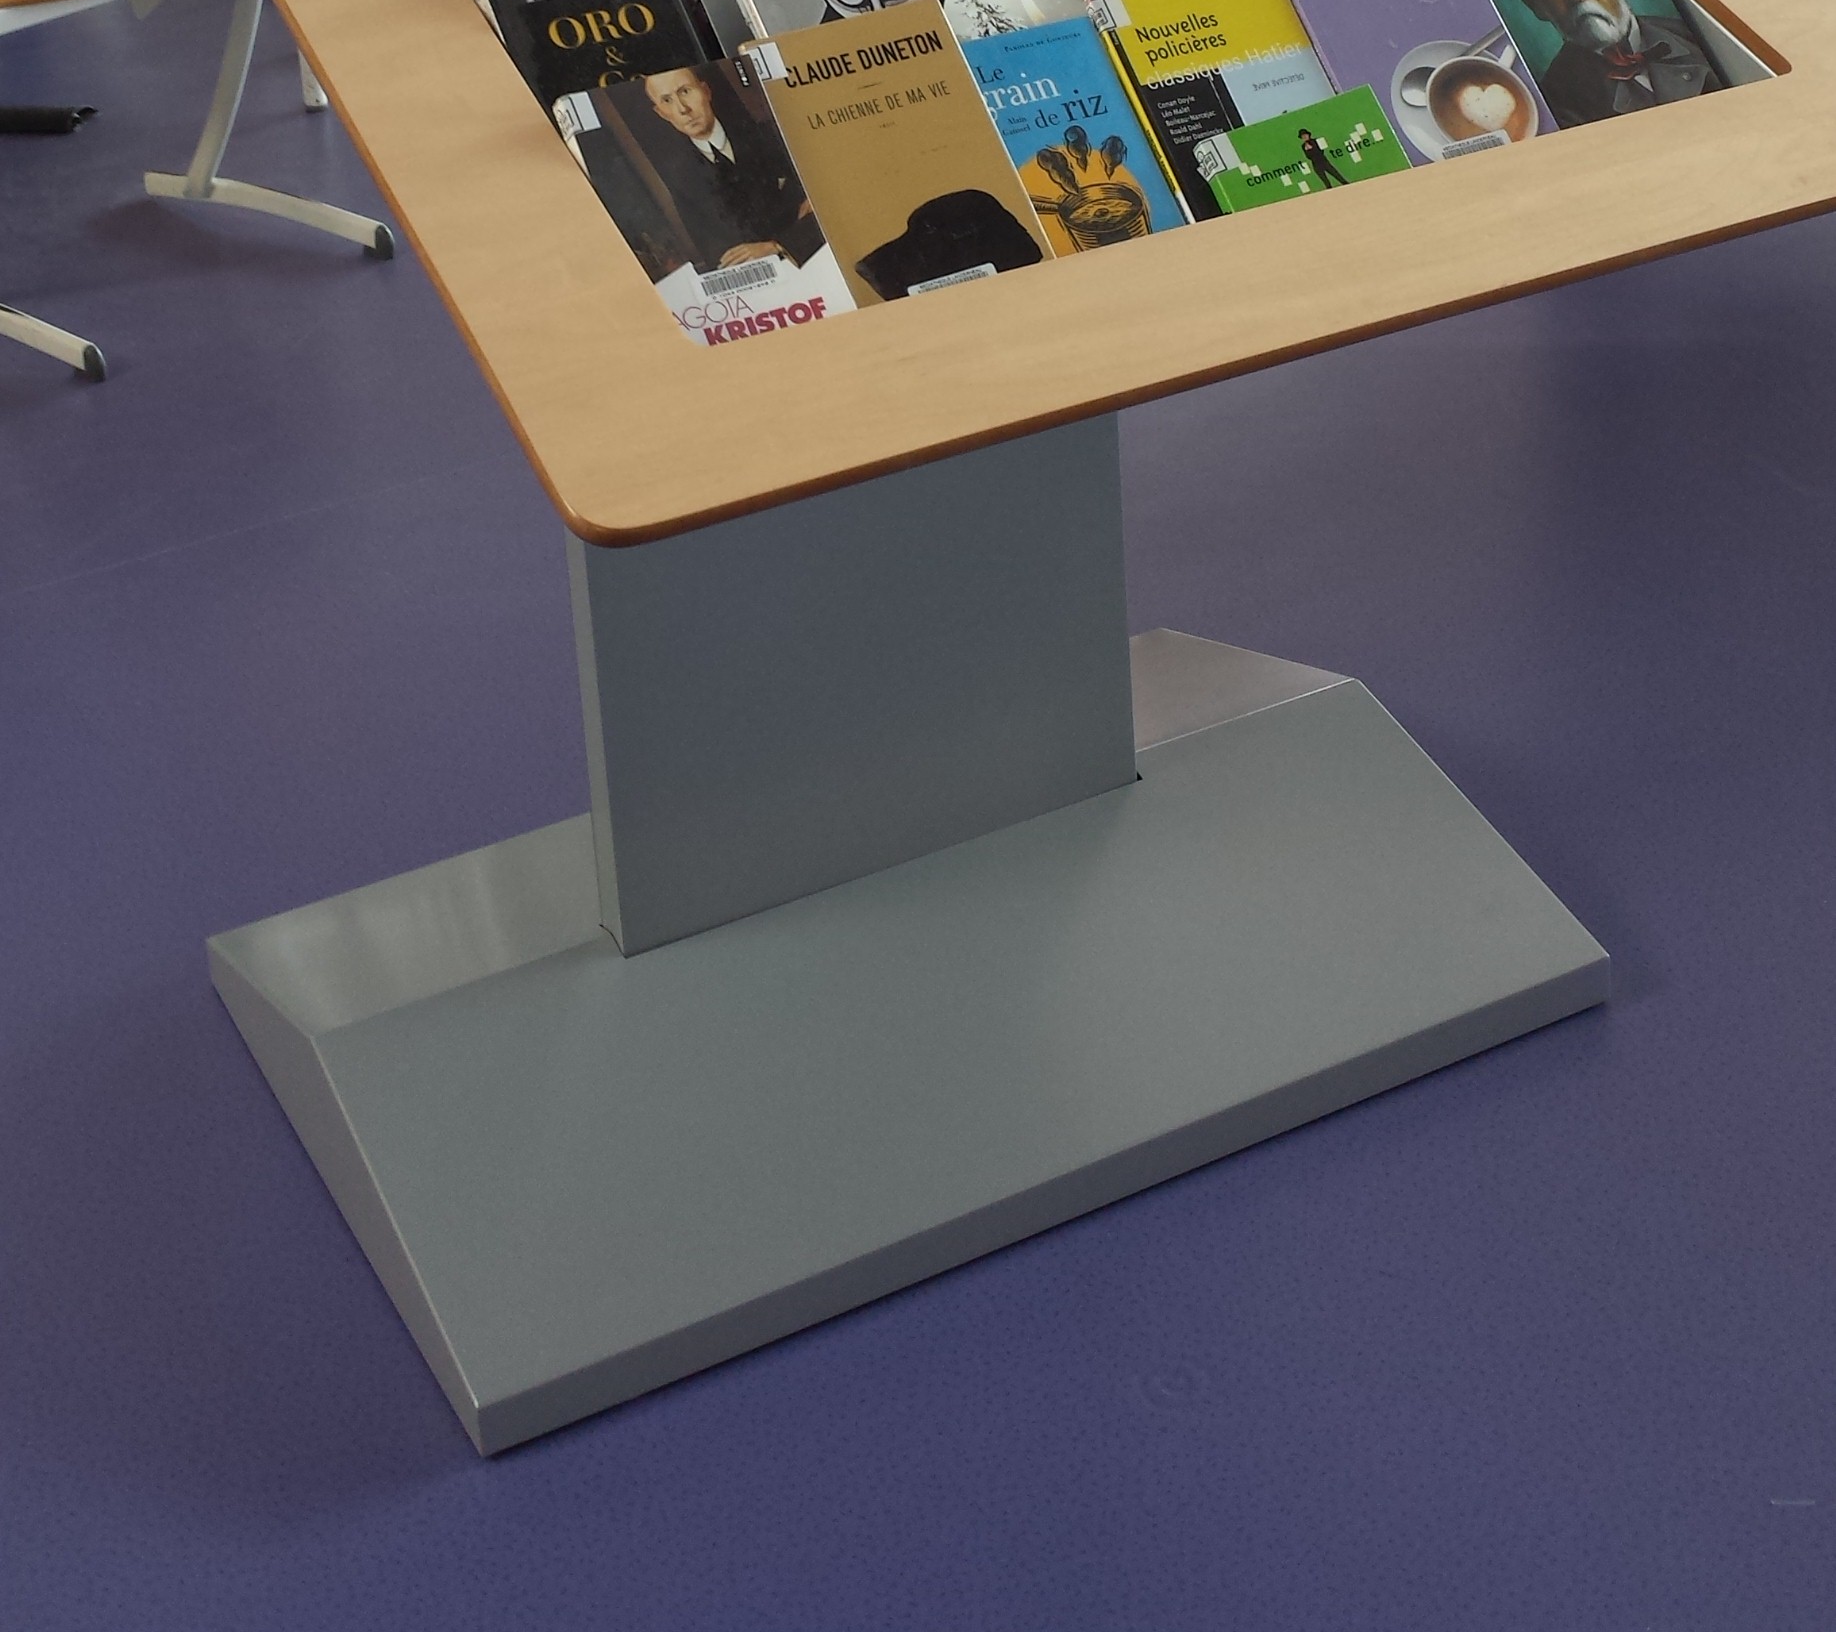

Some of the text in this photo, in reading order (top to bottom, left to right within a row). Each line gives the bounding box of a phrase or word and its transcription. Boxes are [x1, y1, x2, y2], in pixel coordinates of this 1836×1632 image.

[548, 2, 656, 50] ORO
[1135, 12, 1219, 44] Nouvelles
[1144, 31, 1228, 68] policières
[604, 46, 628, 67] &
[784, 30, 944, 89] CLAUDE DUNETON
[976, 66, 1005, 84] Le
[1147, 42, 1304, 91] classiques Hatier
[806, 112, 826, 131] LA
[828, 98, 884, 128] CHIENNE
[884, 92, 904, 112] DE
[906, 86, 927, 105] MA
[929, 80, 951, 100] VIE
[983, 72, 1062, 121] grain
[1034, 88, 1109, 130] de riz
[1156, 98, 1178, 110] Conan
[1246, 136, 1385, 188] comment te dire...
[702, 296, 828, 347] KRISTOF
